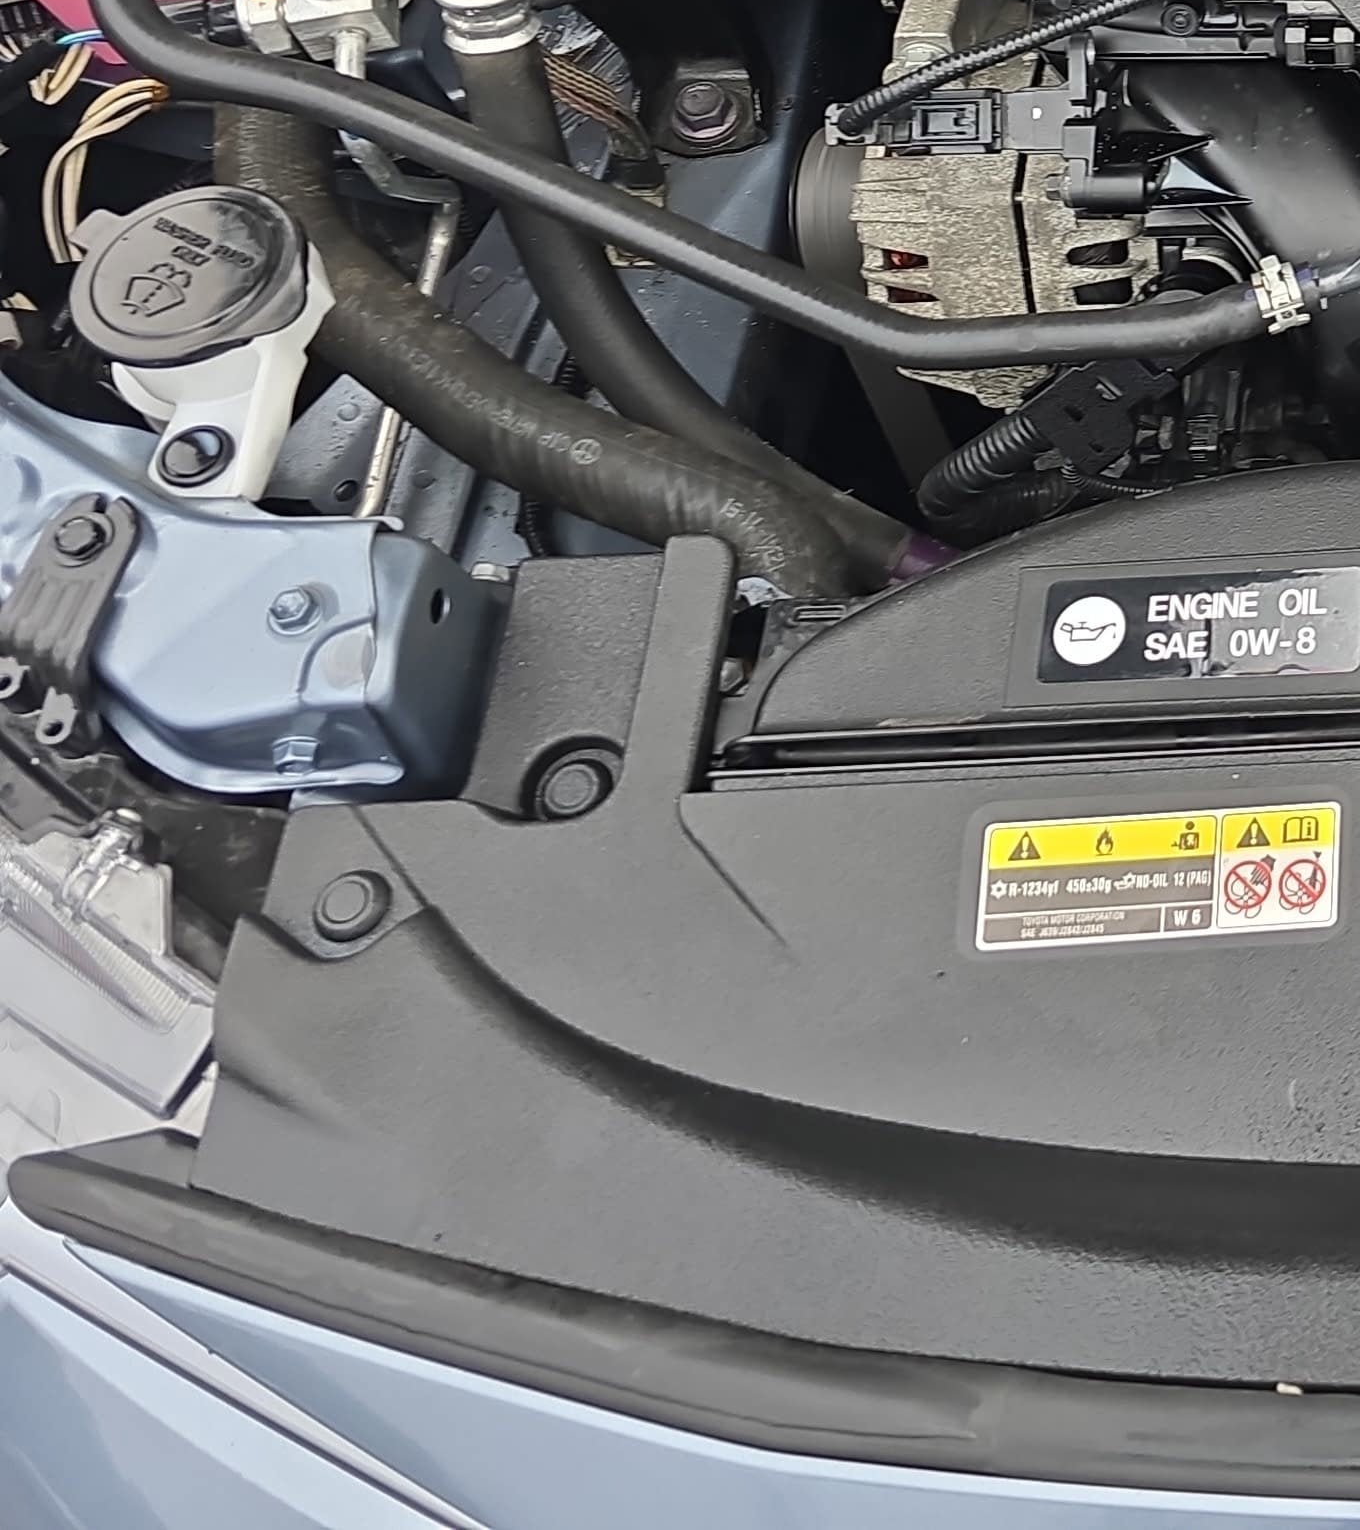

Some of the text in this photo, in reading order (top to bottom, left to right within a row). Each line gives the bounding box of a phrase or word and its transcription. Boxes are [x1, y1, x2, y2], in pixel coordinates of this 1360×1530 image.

[1147, 587, 1328, 623] ENGINE OIL
[1144, 626, 1316, 661] SAE 0W-8
[1007, 880, 1060, 899] R-1234yf
[1174, 871, 1185, 886] 12
[1186, 870, 1212, 888] (PAG)
[1174, 909, 1202, 926] W 6
